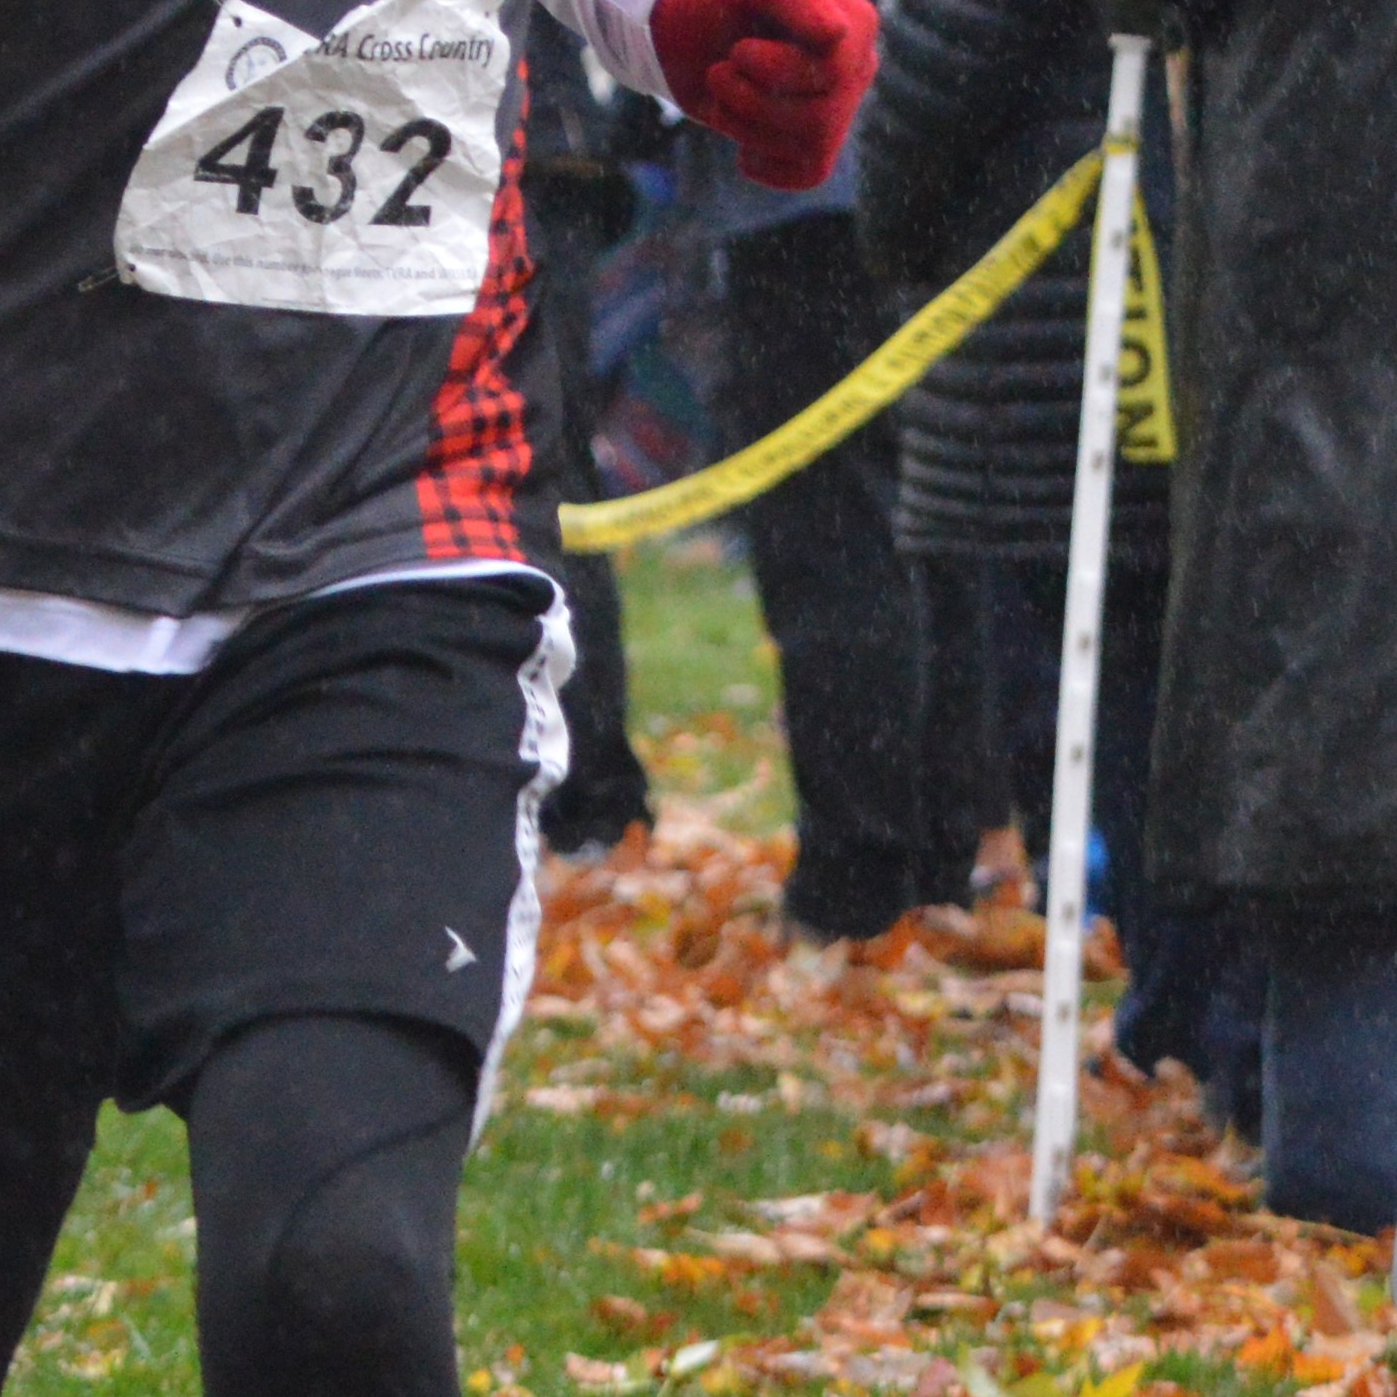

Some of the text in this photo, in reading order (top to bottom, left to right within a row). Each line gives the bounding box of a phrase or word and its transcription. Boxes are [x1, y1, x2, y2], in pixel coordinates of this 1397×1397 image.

[357, 33, 413, 61] Cross
[418, 33, 495, 68] Country
[194, 107, 452, 226] 432
